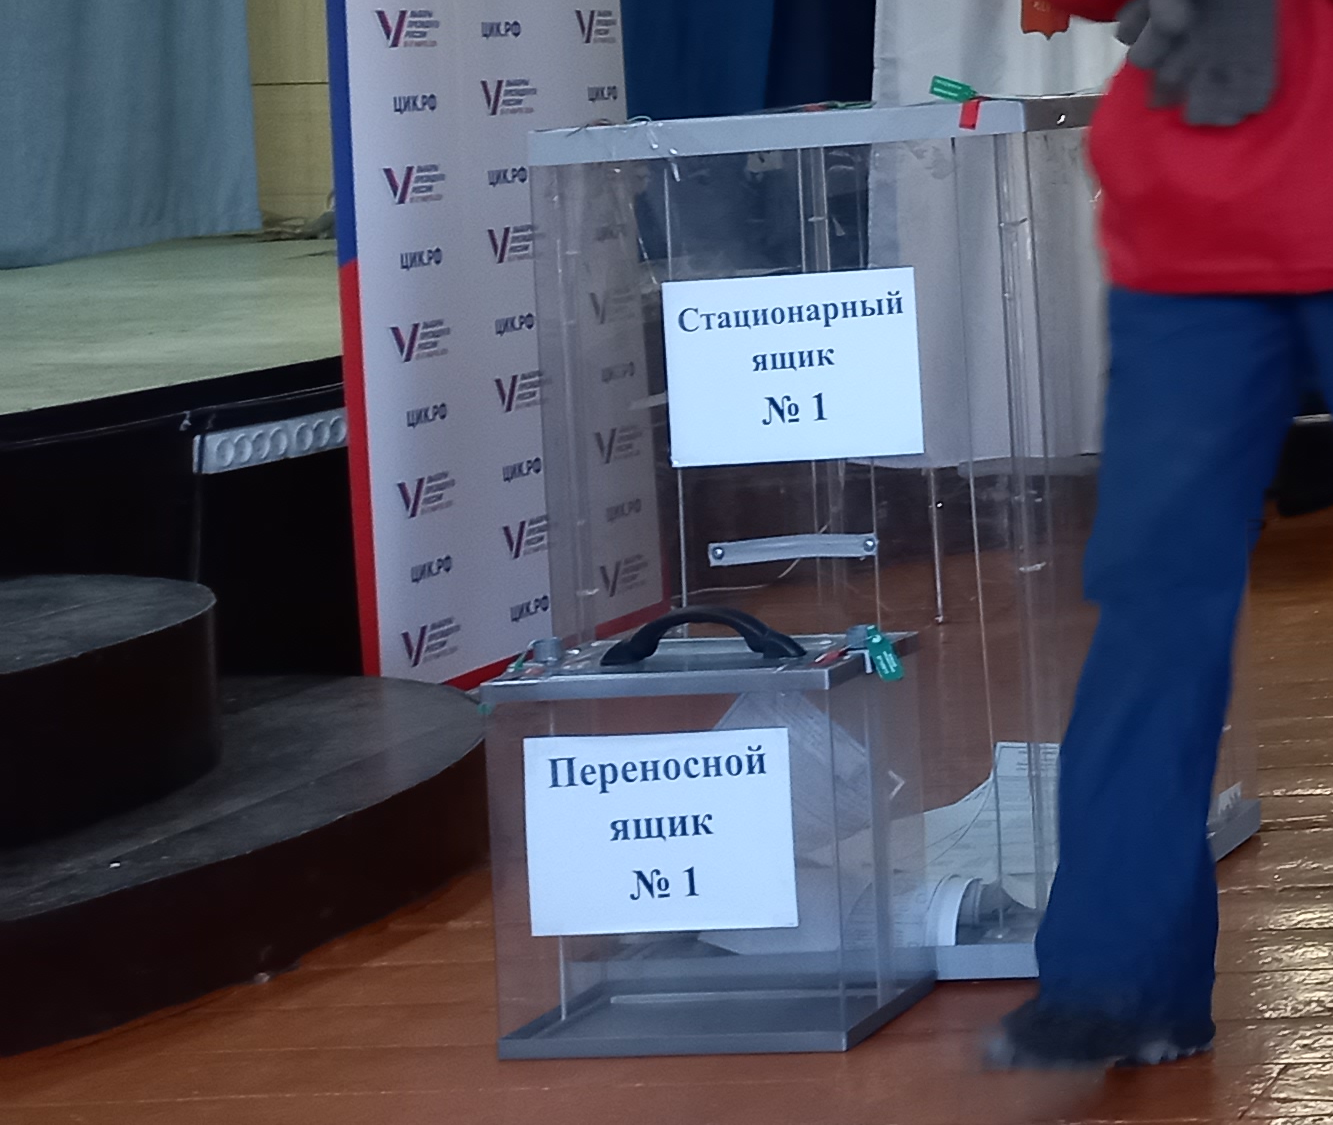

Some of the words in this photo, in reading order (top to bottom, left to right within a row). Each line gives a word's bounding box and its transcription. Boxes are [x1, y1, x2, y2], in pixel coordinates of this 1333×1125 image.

[481, 20, 521, 39] ЦИК.РФ
[393, 93, 437, 114] ЦИК.РФ
[400, 247, 442, 271] ЦИК.РФ
[678, 290, 904, 332] Стационарный
[495, 313, 535, 336] ЦИК.РФ
[752, 348, 835, 371] ящик
[406, 403, 447, 428] ЦИК.РФ
[762, 395, 800, 425] №
[812, 392, 828, 421] 1
[502, 457, 541, 482] ЦИК.РФ
[548, 744, 767, 794] Переносной
[610, 814, 714, 842] ящик
[629, 869, 670, 900] №
[683, 866, 699, 897] 1
